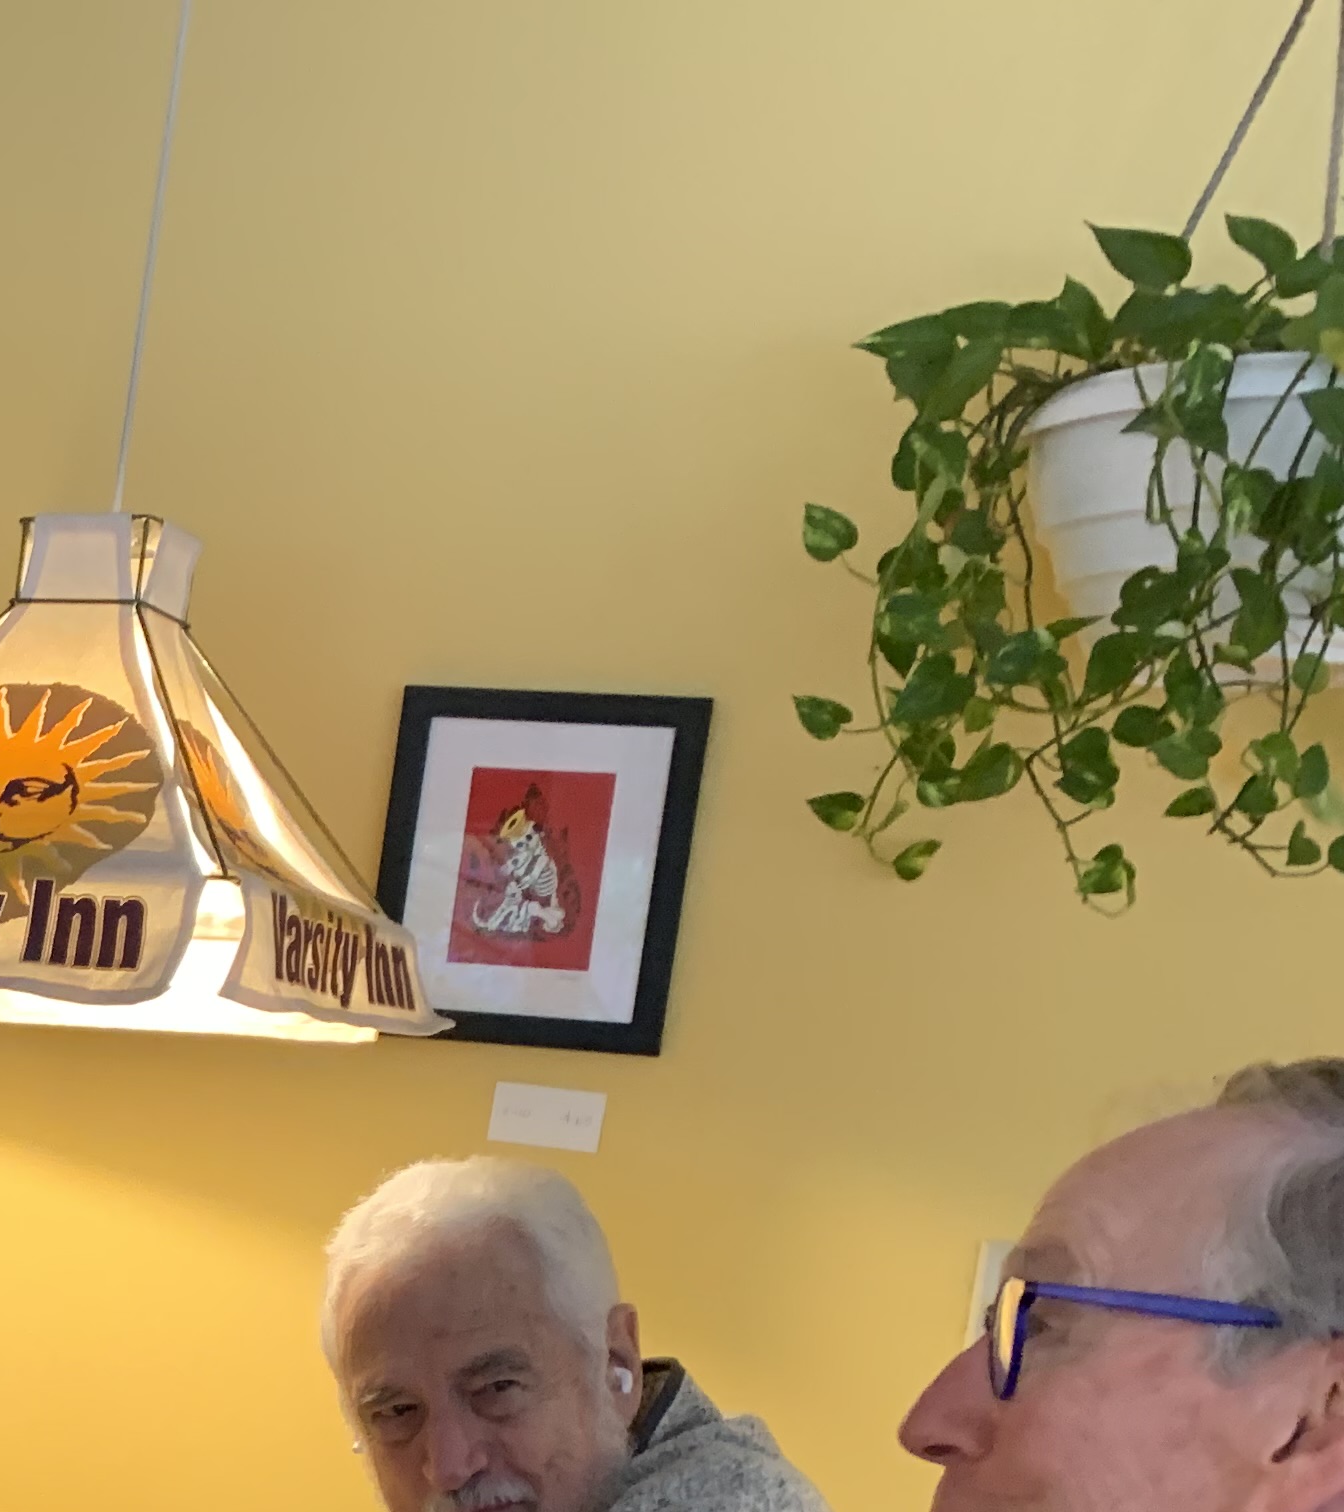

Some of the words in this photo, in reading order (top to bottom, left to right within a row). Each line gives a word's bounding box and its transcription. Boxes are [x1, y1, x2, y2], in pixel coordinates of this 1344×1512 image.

[19, 877, 148, 971] Inn
[271, 890, 359, 1010] Varsity
[365, 923, 416, 1012] Inn
